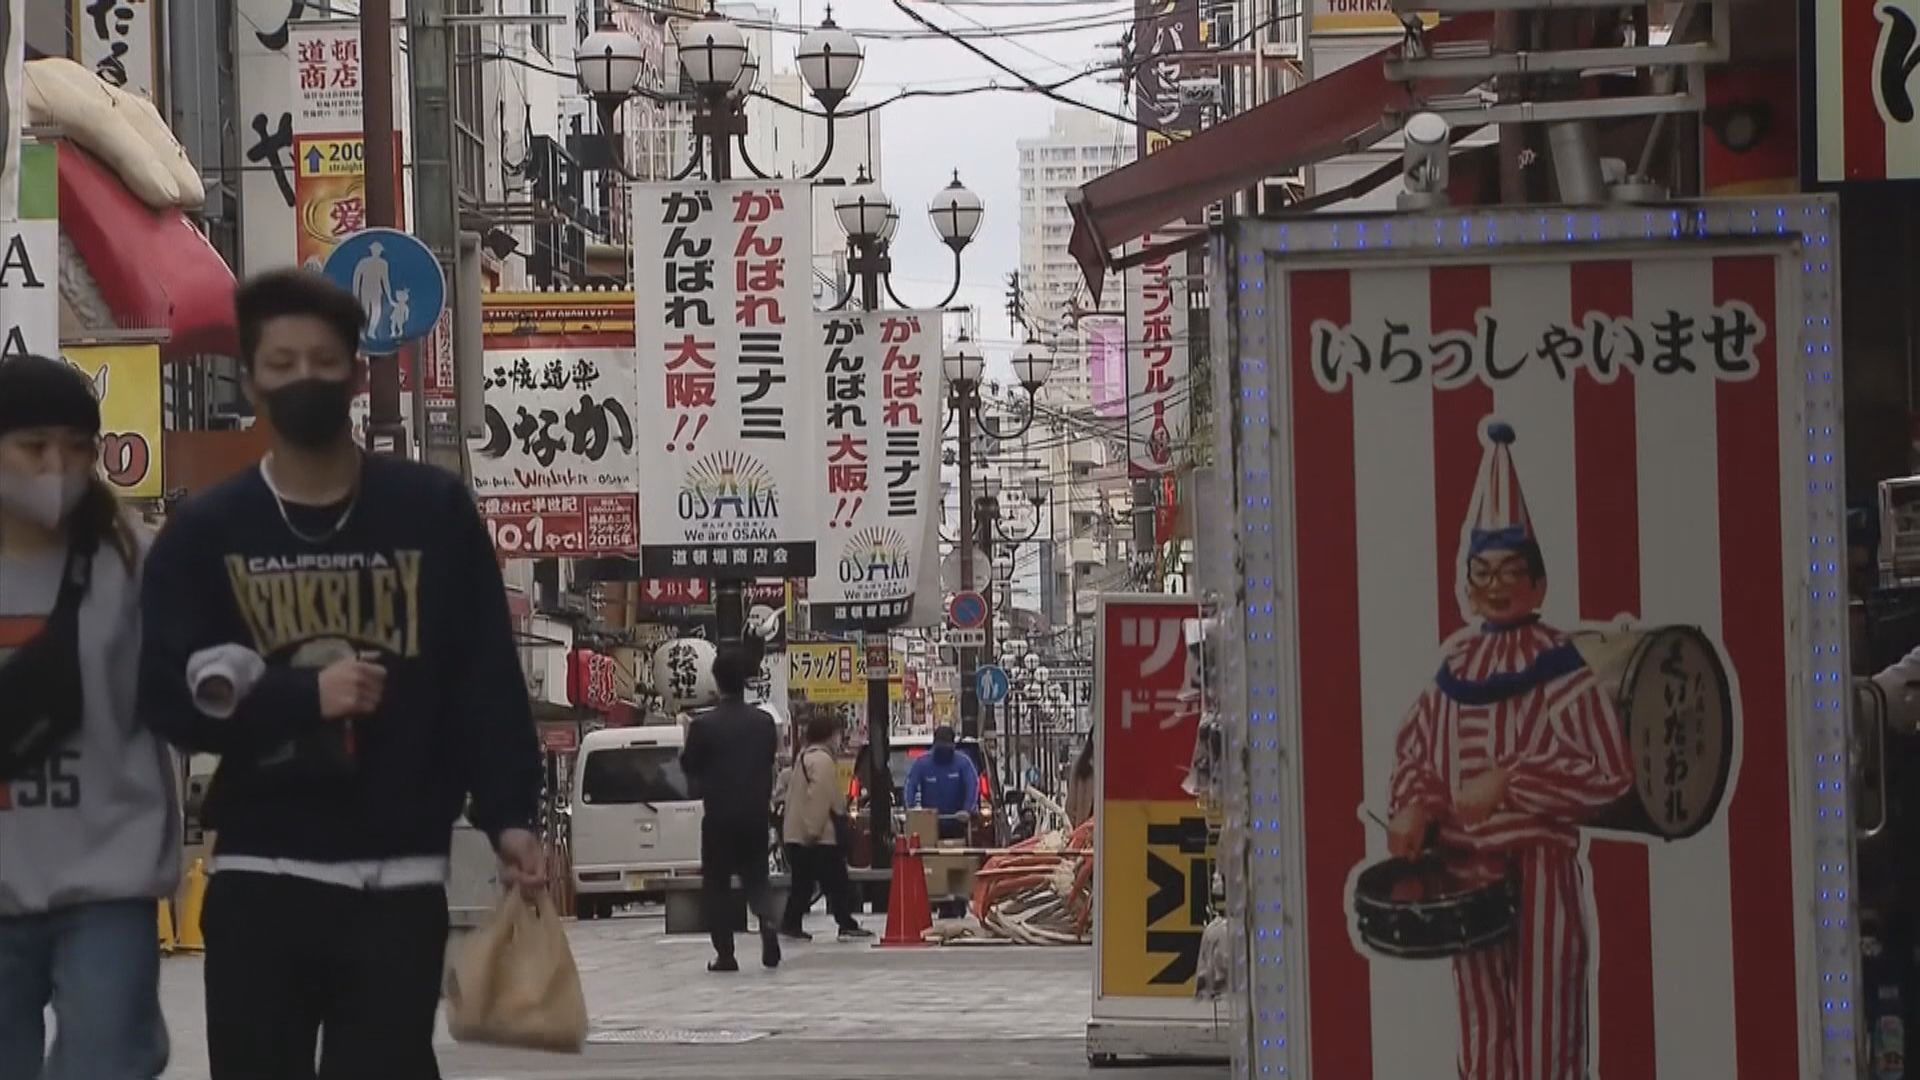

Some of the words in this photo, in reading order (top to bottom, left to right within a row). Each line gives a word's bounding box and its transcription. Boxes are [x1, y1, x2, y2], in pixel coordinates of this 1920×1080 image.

[733, 189, 786, 440] がんばれミナミ
[1320, 309, 1757, 384] いらっしゃいませ
[879, 317, 923, 517] がんばれミナミ
[678, 470, 779, 520] OSAKA
[684, 530, 704, 541] We
[708, 531, 728, 541] are
[732, 528, 777, 540] OSAKA
[249, 553, 389, 572] CALIFORNIA
[844, 589, 859, 600] We
[789, 651, 838, 680] ドラッグ
[1121, 689, 1199, 730] ドラ
